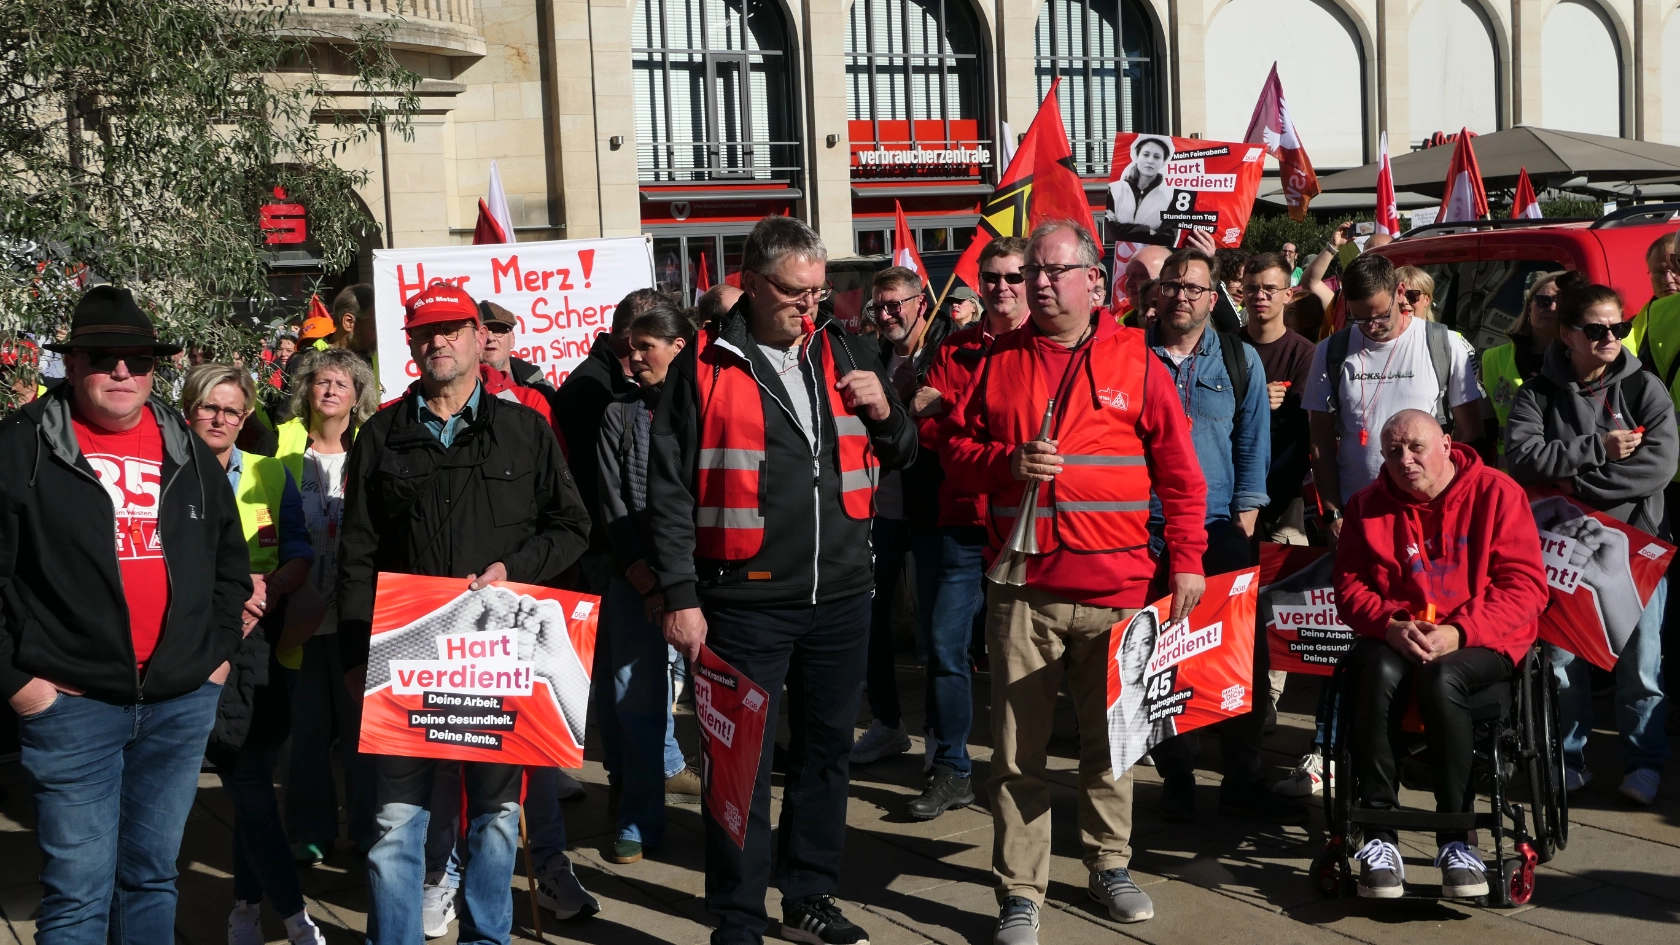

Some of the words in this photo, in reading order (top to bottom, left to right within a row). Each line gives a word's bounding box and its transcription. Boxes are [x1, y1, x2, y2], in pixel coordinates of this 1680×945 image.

[859, 145, 990, 165] verbraucherzentrale
[1173, 152, 1189, 160] Mein
[1190, 147, 1228, 158] Feierabend:
[1167, 163, 1201, 175] Hart
[1165, 175, 1234, 188] verdient!
[1175, 192, 1191, 211] 8
[1193, 225, 1214, 233] genug
[436, 296, 459, 304] Metall
[531, 296, 617, 334] Scher
[550, 333, 591, 359] sind
[1641, 549, 1656, 559] DGB
[1232, 585, 1246, 594] DGB
[1310, 590, 1336, 606] Ha
[574, 611, 587, 619] DGB
[1278, 608, 1346, 626] verdi
[1161, 621, 1171, 632] Me
[1301, 629, 1325, 638] Deine
[1326, 632, 1354, 640] Arbeit.
[1157, 622, 1186, 655] Hart
[446, 634, 511, 660] Hart
[1151, 626, 1218, 673] verdient!
[1290, 643, 1315, 651] Deine
[1315, 644, 1350, 652] Gesund
[1303, 653, 1328, 663] Deine
[397, 663, 531, 690] verdient!
[694, 681, 709, 703] art
[1147, 671, 1172, 701] 45
[428, 693, 462, 706] Deine
[463, 696, 501, 709] Arbeit.
[1150, 690, 1192, 713] Beitragsjahre
[411, 714, 446, 725] Deine
[447, 714, 513, 726] Gesundheit.
[1150, 709, 1162, 721] sind
[1161, 705, 1184, 719] genug
[697, 702, 732, 742] rdient!
[429, 729, 463, 742] Deine
[464, 731, 499, 746] Rente.
